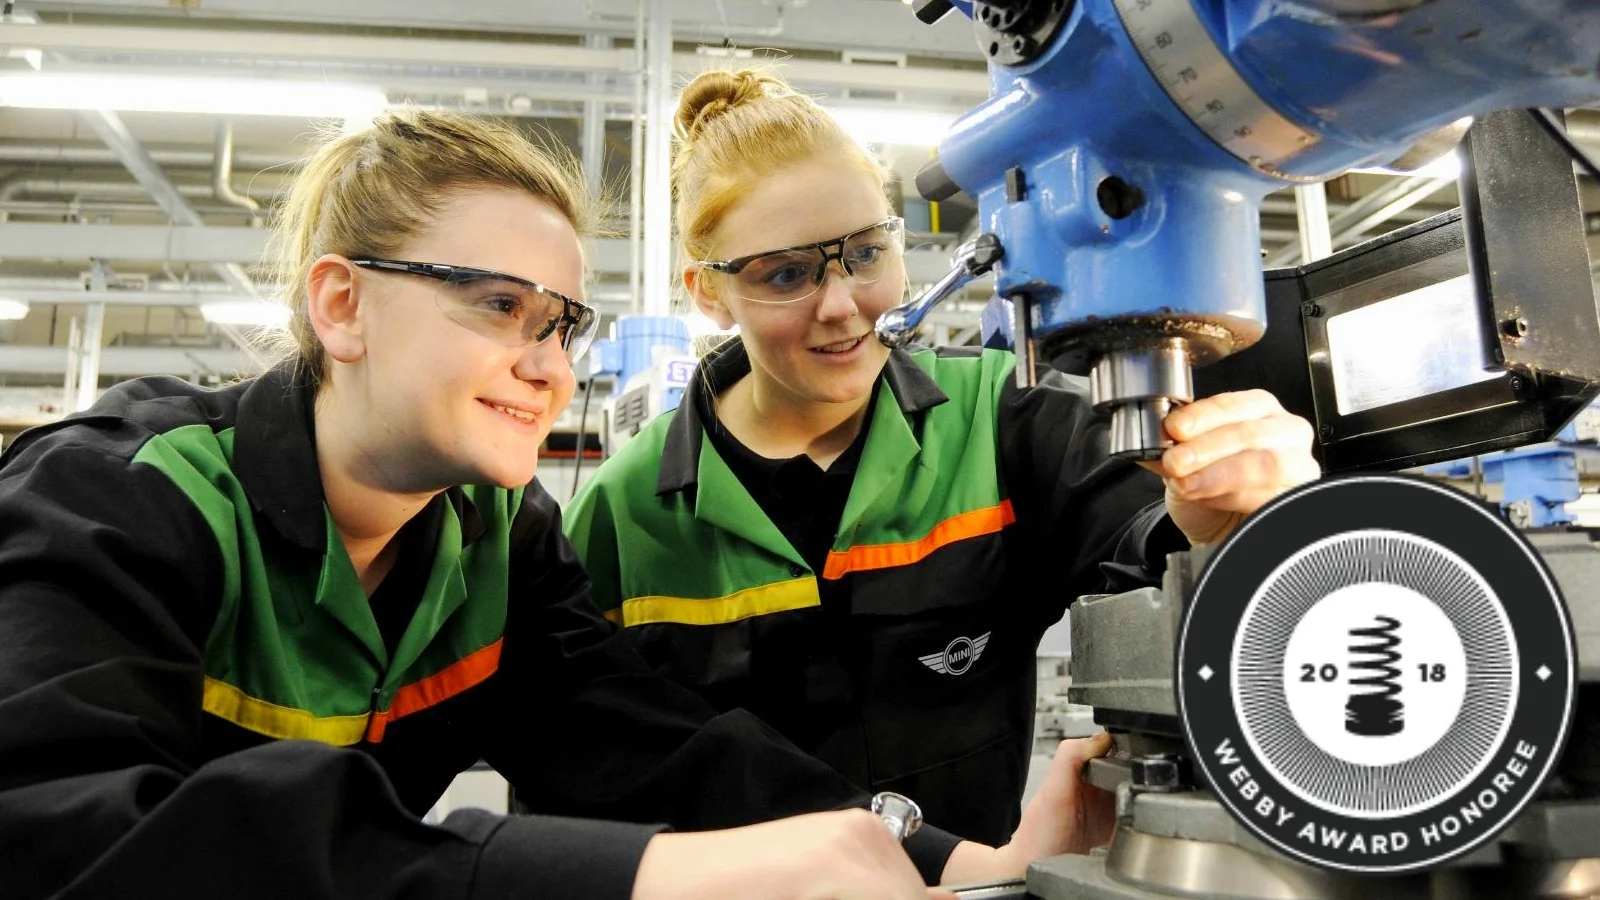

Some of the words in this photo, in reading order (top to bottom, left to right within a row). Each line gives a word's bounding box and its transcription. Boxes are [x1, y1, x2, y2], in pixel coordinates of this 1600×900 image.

[1155, 31, 1172, 49] 60
[1179, 67, 1197, 84] 70
[1205, 99, 1224, 114] 80
[949, 647, 971, 664] MINI
